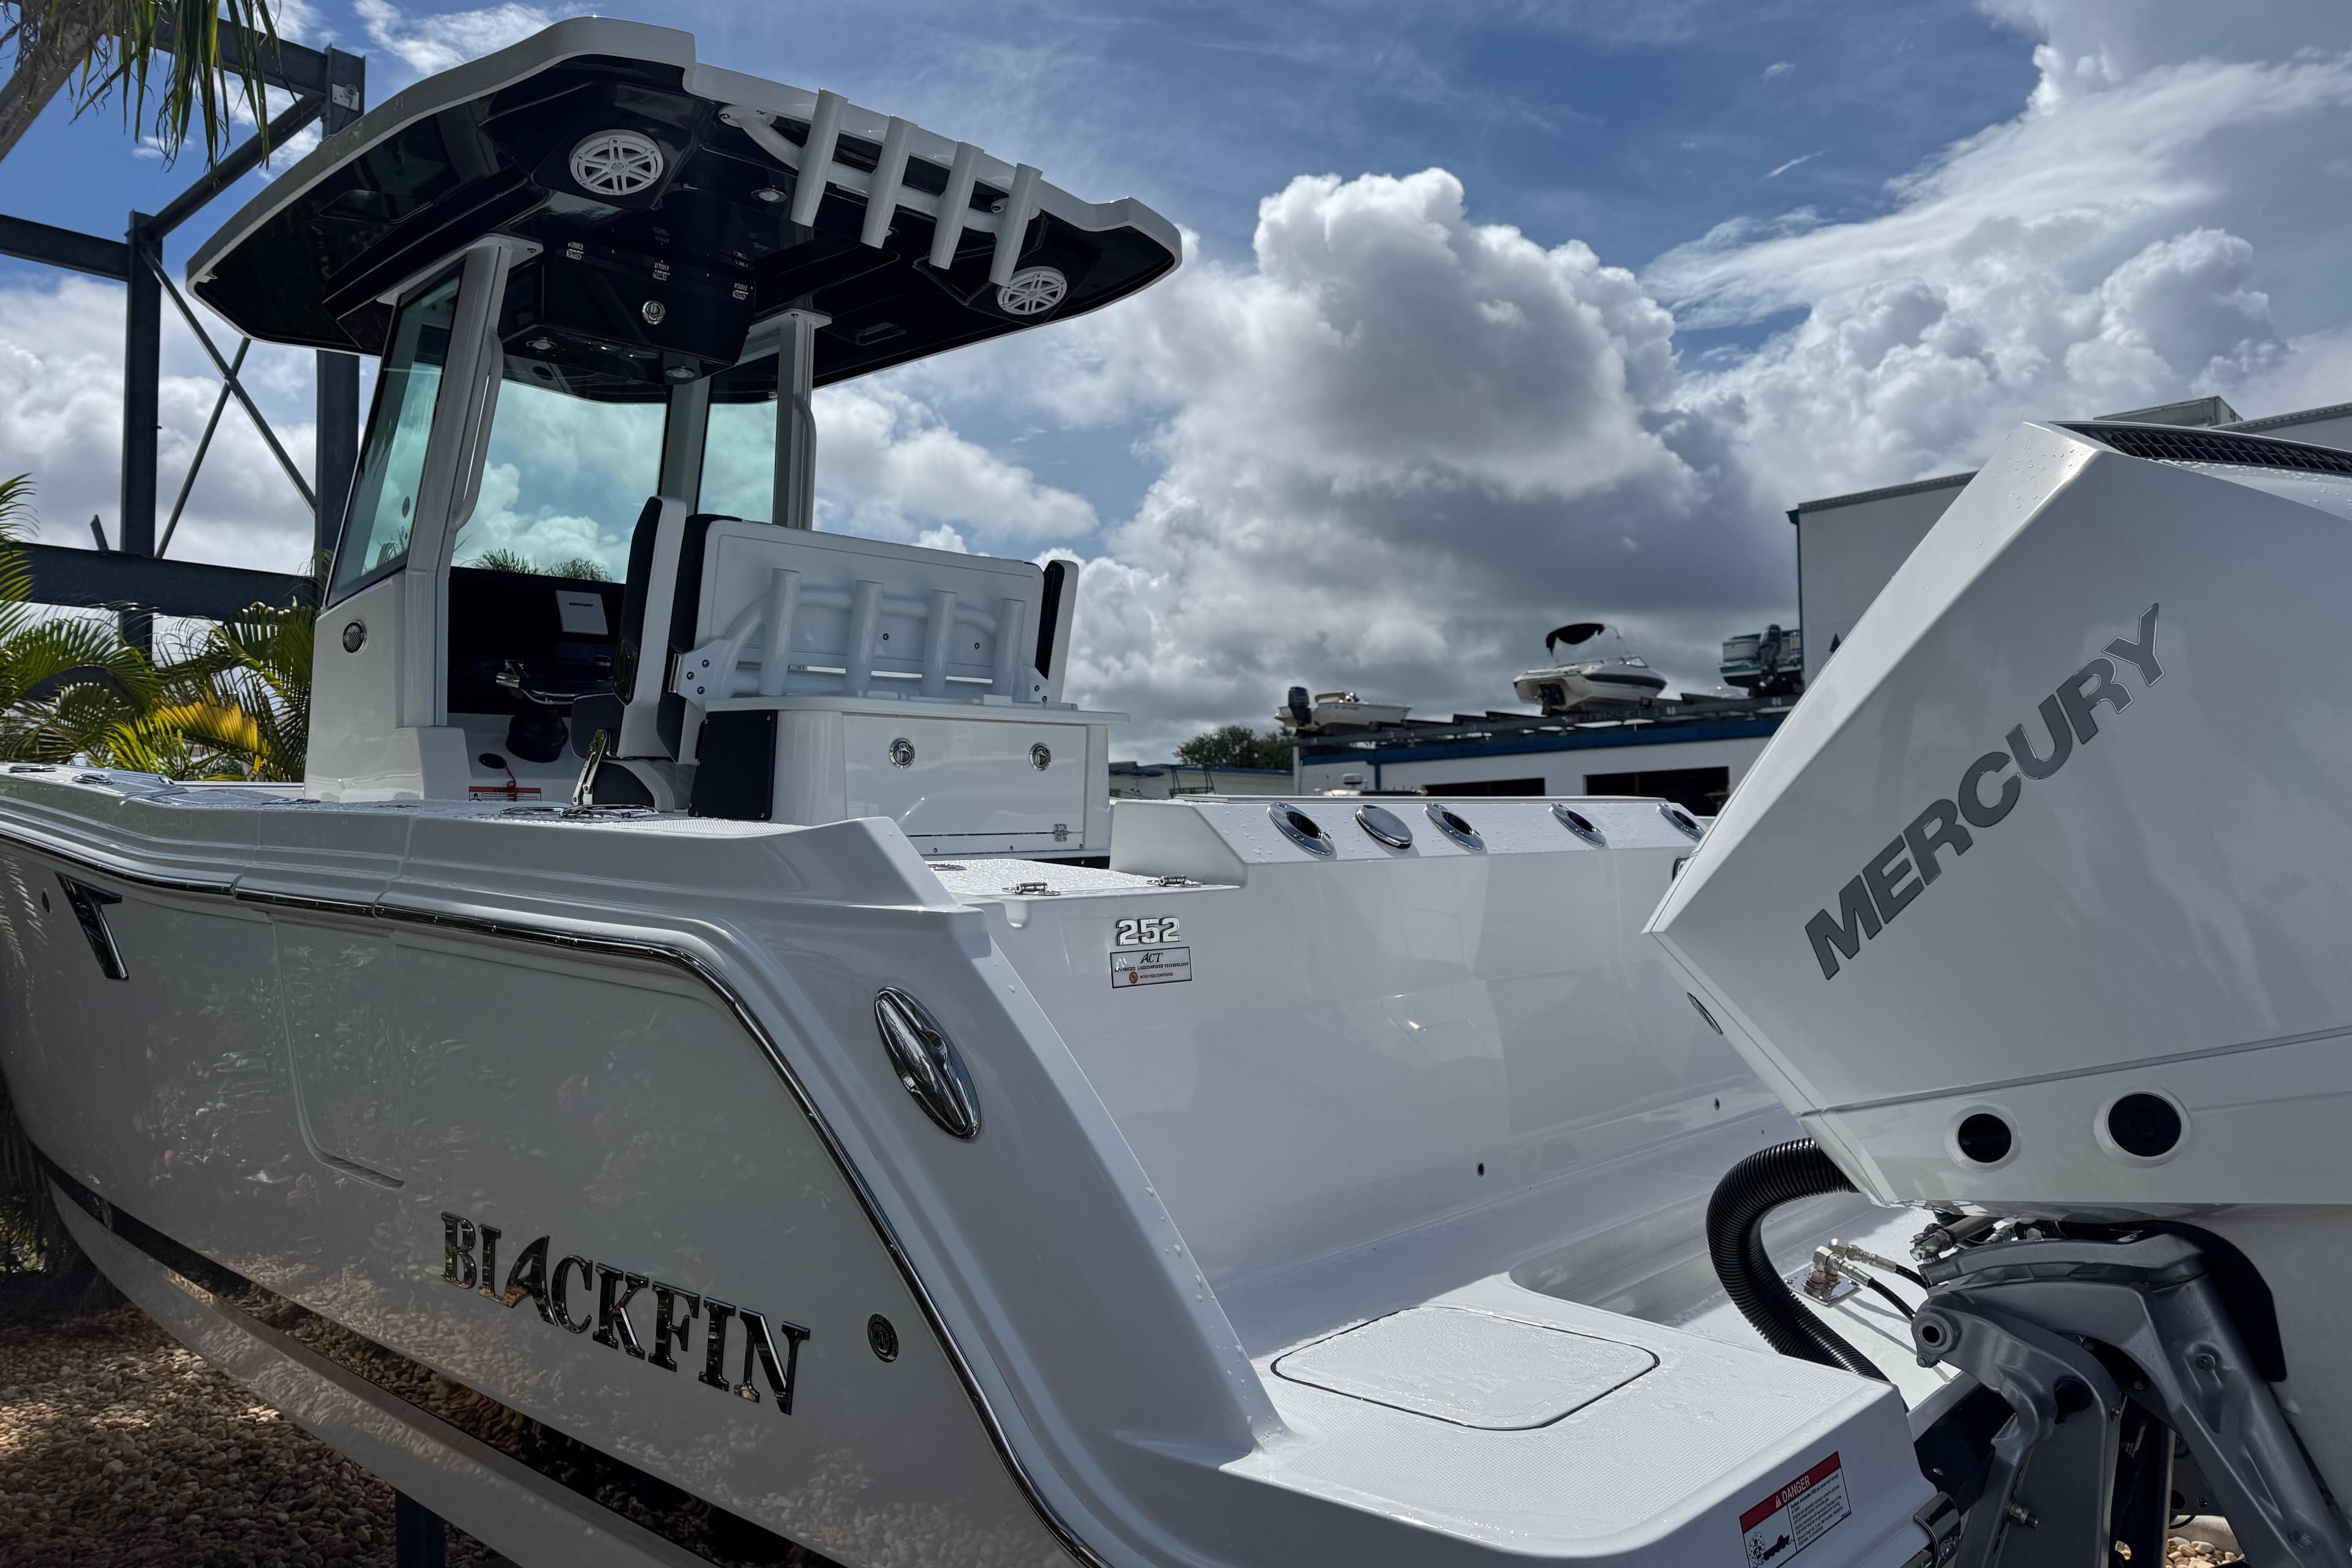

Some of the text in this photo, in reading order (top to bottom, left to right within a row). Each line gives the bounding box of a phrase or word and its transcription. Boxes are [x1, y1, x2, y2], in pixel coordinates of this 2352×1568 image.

[1805, 603, 2165, 980] MERCURY
[1115, 917, 1181, 946] 252
[1140, 952, 1163, 963] ACT
[440, 1211, 810, 1415] BLACKFIN
[1782, 1475, 1811, 1504] DANGER
